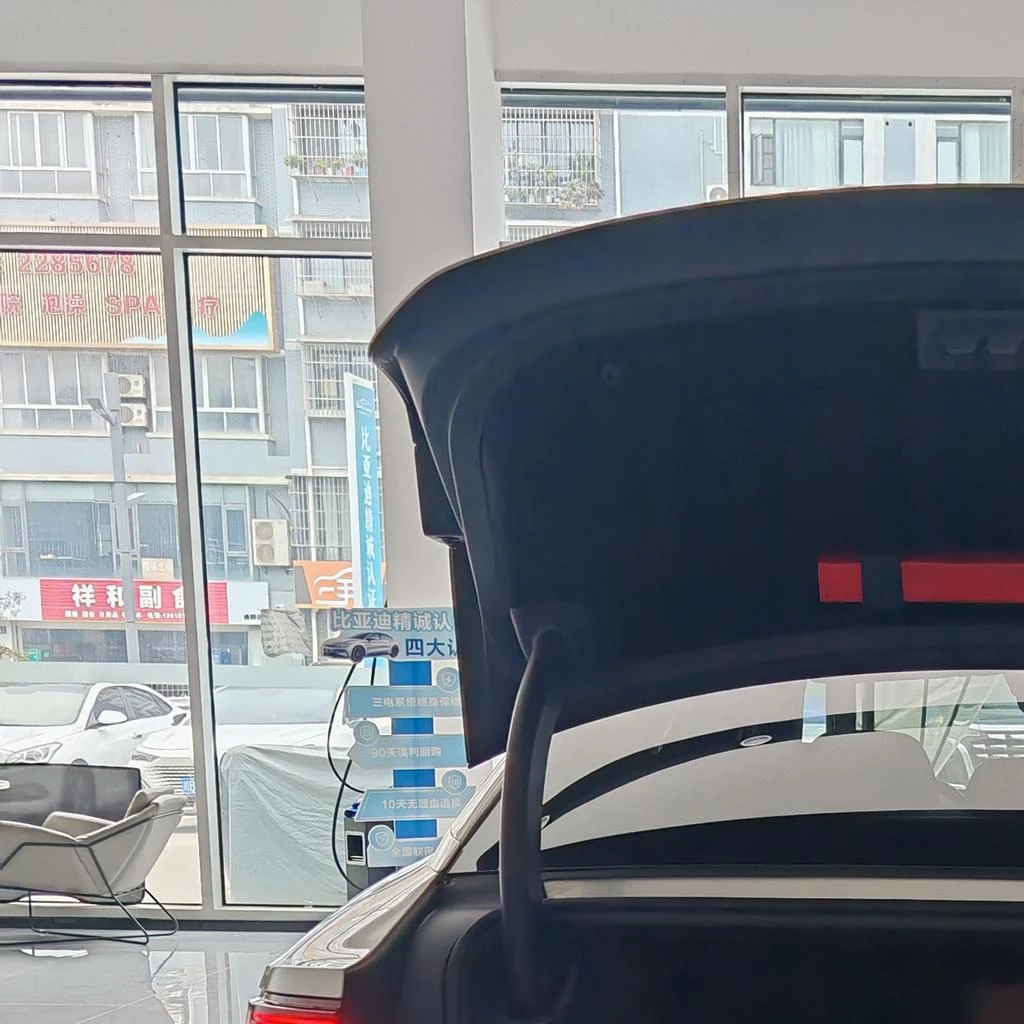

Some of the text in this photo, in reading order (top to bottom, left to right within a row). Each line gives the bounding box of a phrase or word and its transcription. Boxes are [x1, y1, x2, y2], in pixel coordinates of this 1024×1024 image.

[42, 293, 87, 316] 泡澡
[106, 295, 163, 316] SPA
[194, 296, 220, 318] 疗
[333, 611, 453, 631] 比亚迪精诚认
